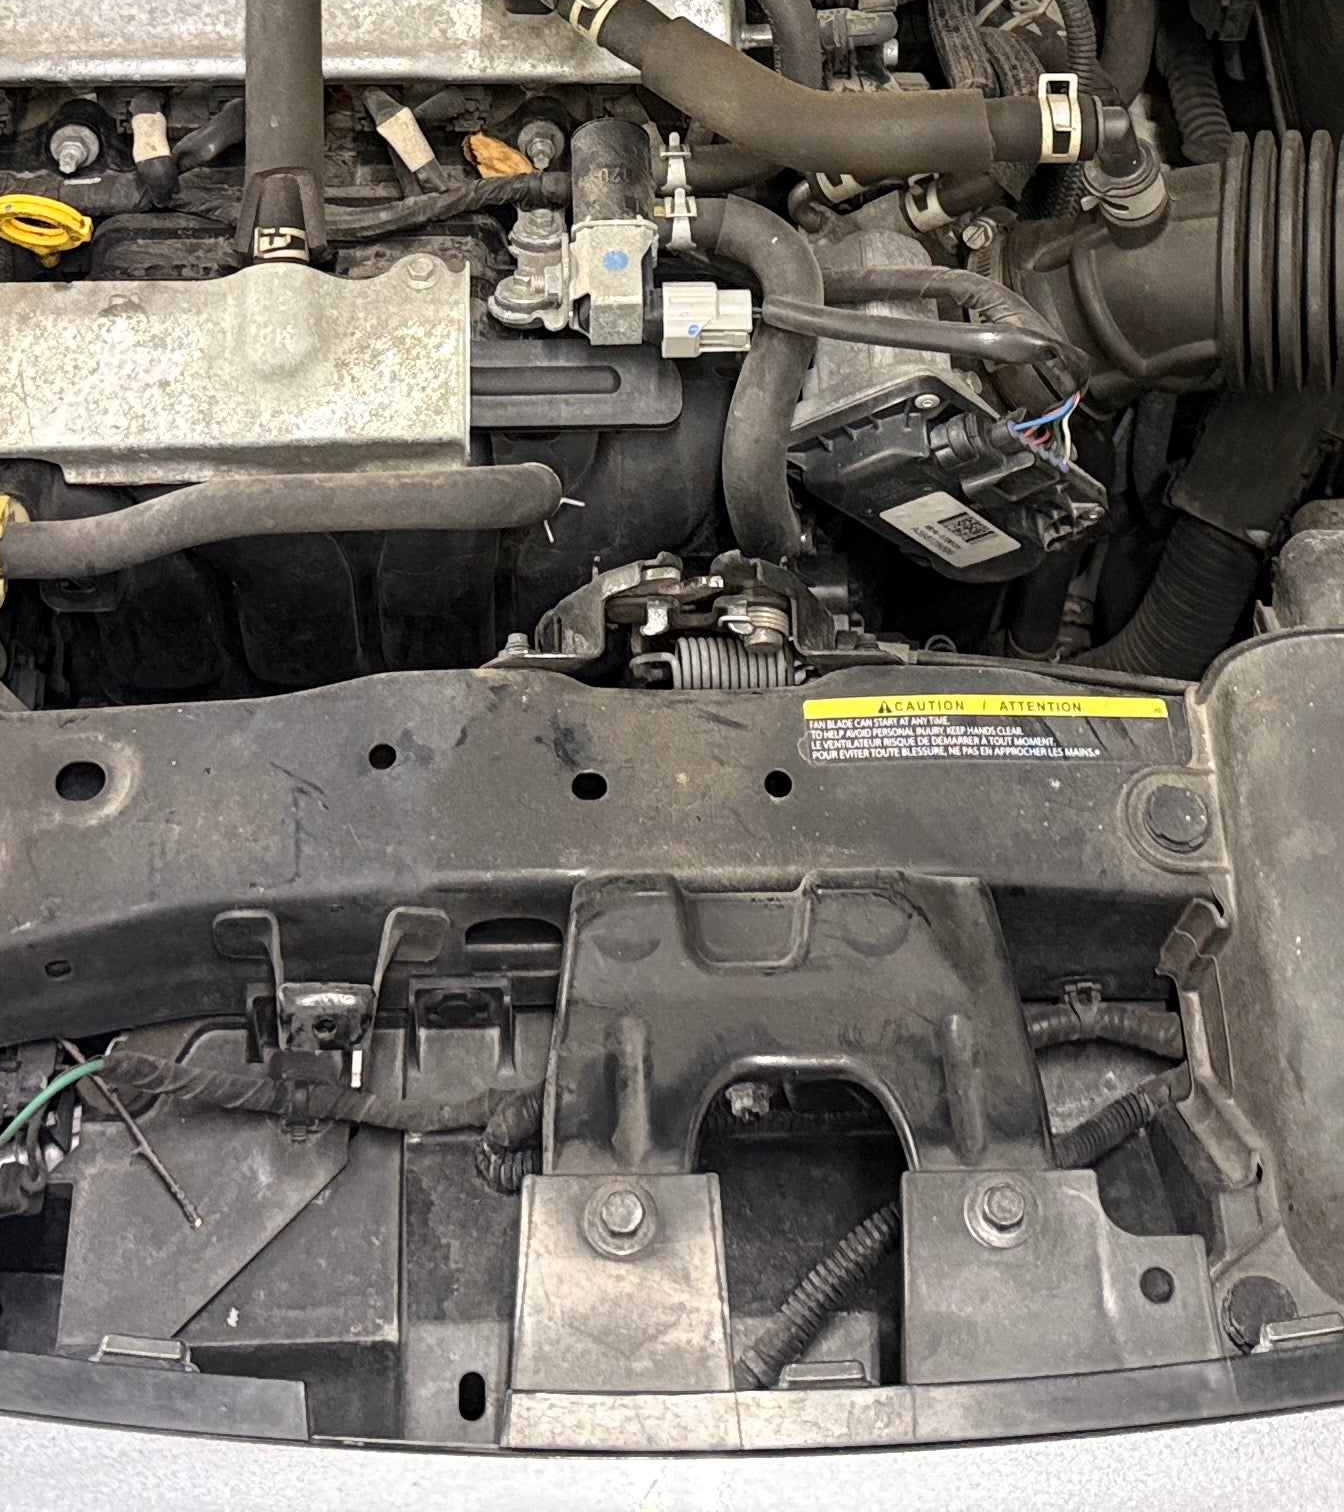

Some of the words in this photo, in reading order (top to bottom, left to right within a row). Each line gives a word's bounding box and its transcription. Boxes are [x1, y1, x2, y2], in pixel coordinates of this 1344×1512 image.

[895, 700, 965, 712] CAUTION
[999, 701, 1082, 713] ATTENTION
[809, 719, 826, 729] FAN
[827, 718, 853, 729] BLADE
[854, 718, 873, 728] CAN
[873, 717, 898, 727] START
[899, 717, 909, 726] AT
[911, 716, 928, 726] ANY
[810, 730, 823, 739] TO
[824, 729, 844, 739] HELP
[845, 728, 872, 738] AVOID
[873, 727, 915, 737] PERSONAL
[946, 726, 966, 736] KEEP
[967, 726, 996, 736] HANDS
[811, 740, 821, 750] LE
[822, 738, 882, 750] VENTILATEUR
[883, 737, 915, 748] RISQUE
[917, 737, 930, 746] DE
[989, 737, 1013, 746] TOUT
[812, 750, 839, 760] POUR
[871, 748, 900, 757] TOUTE
[948, 747, 962, 756] NE
[962, 746, 979, 756] PAS
[980, 746, 992, 756] EN
[994, 747, 1047, 757] APPROCHER
[1048, 747, 1063, 757] LES
